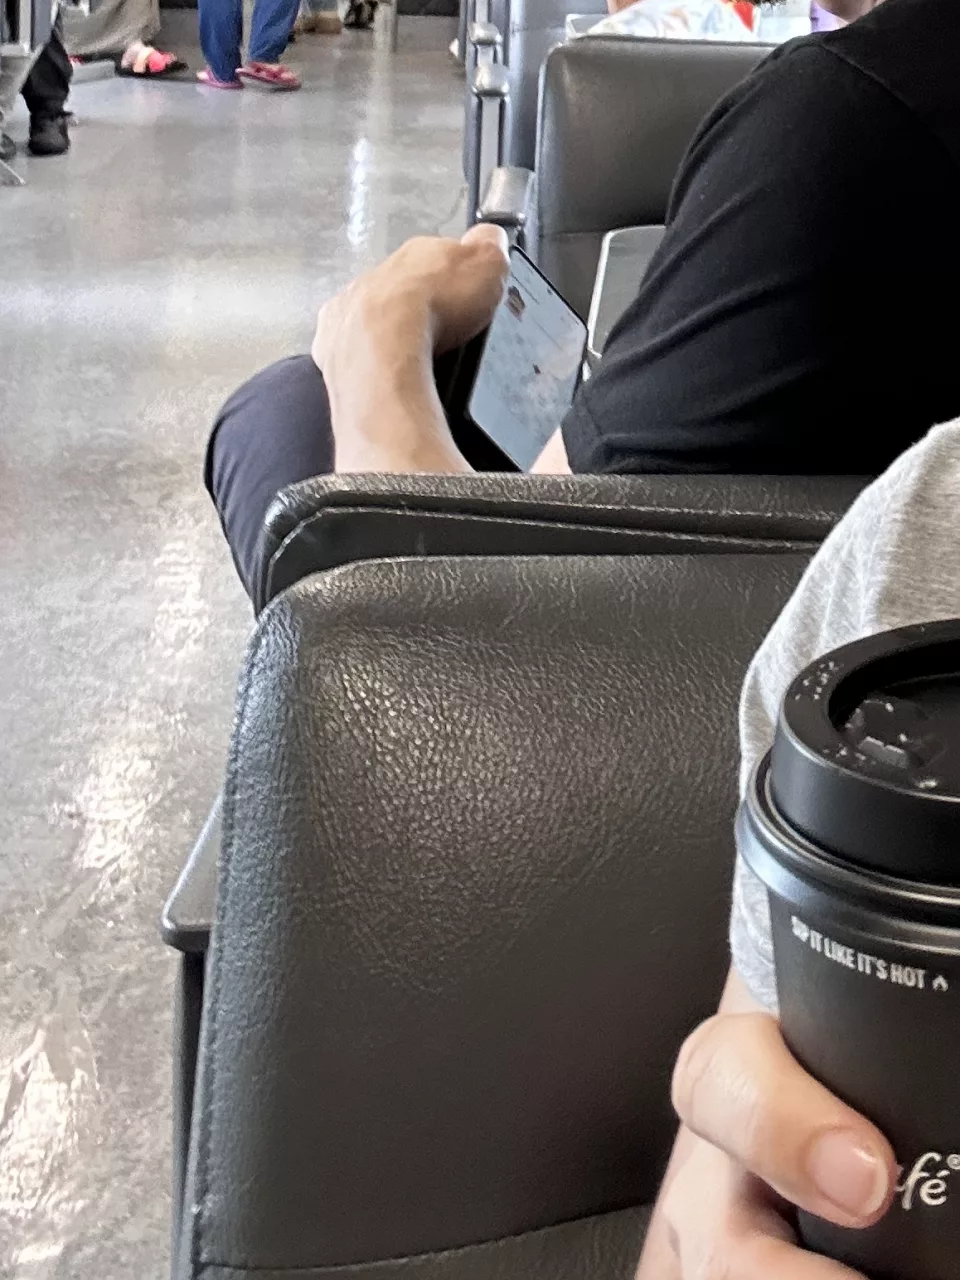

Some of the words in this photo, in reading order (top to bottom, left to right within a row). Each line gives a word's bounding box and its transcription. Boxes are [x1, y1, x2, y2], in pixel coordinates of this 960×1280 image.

[810, 930, 823, 953] IT
[824, 937, 855, 969] LIKE
[857, 952, 888, 980] IT'S
[890, 963, 926, 990] HOT
[894, 1151, 951, 1211] fé
